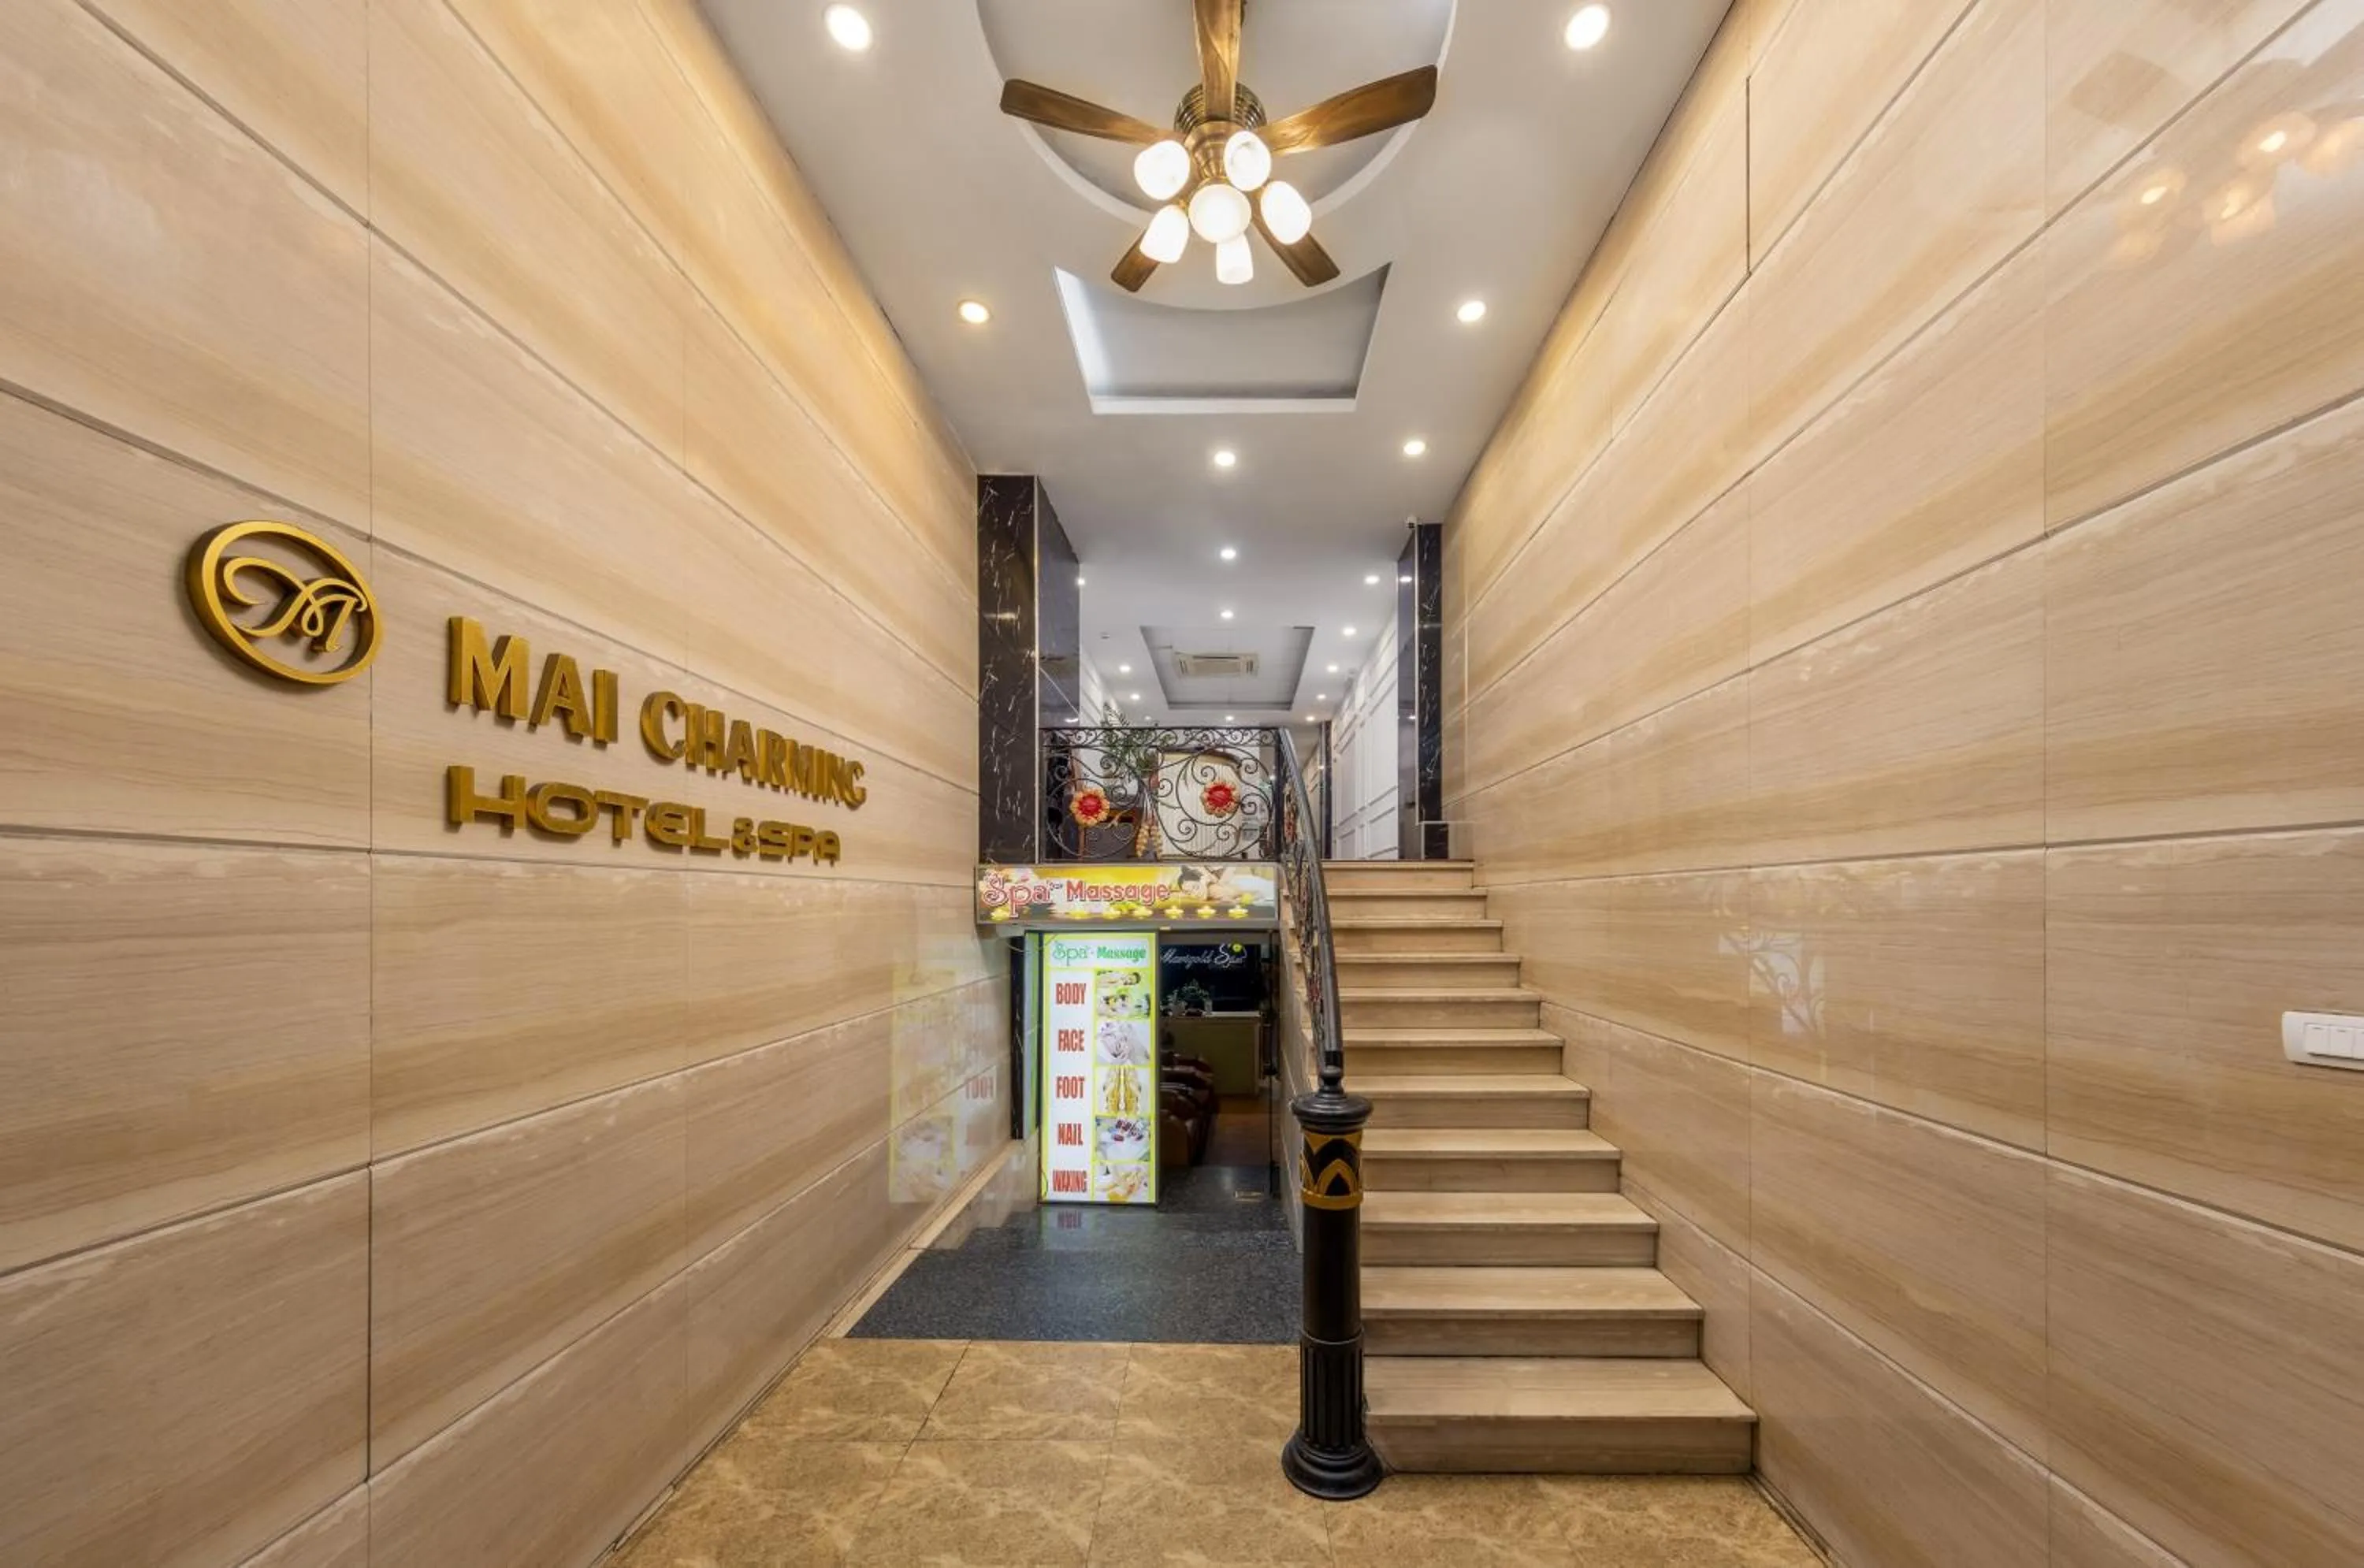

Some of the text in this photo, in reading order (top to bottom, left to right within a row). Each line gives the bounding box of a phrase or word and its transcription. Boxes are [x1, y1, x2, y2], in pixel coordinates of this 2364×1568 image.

[448, 616, 867, 808] MAI CHARMING
[983, 870, 1169, 918] Spa Massage
[1052, 941, 1147, 966] Spa Massage
[1055, 983, 1087, 1005] BODY
[1057, 1029, 1085, 1052] FACE
[1056, 1076, 1085, 1099] FOOT
[1057, 1123, 1084, 1146] NAIL
